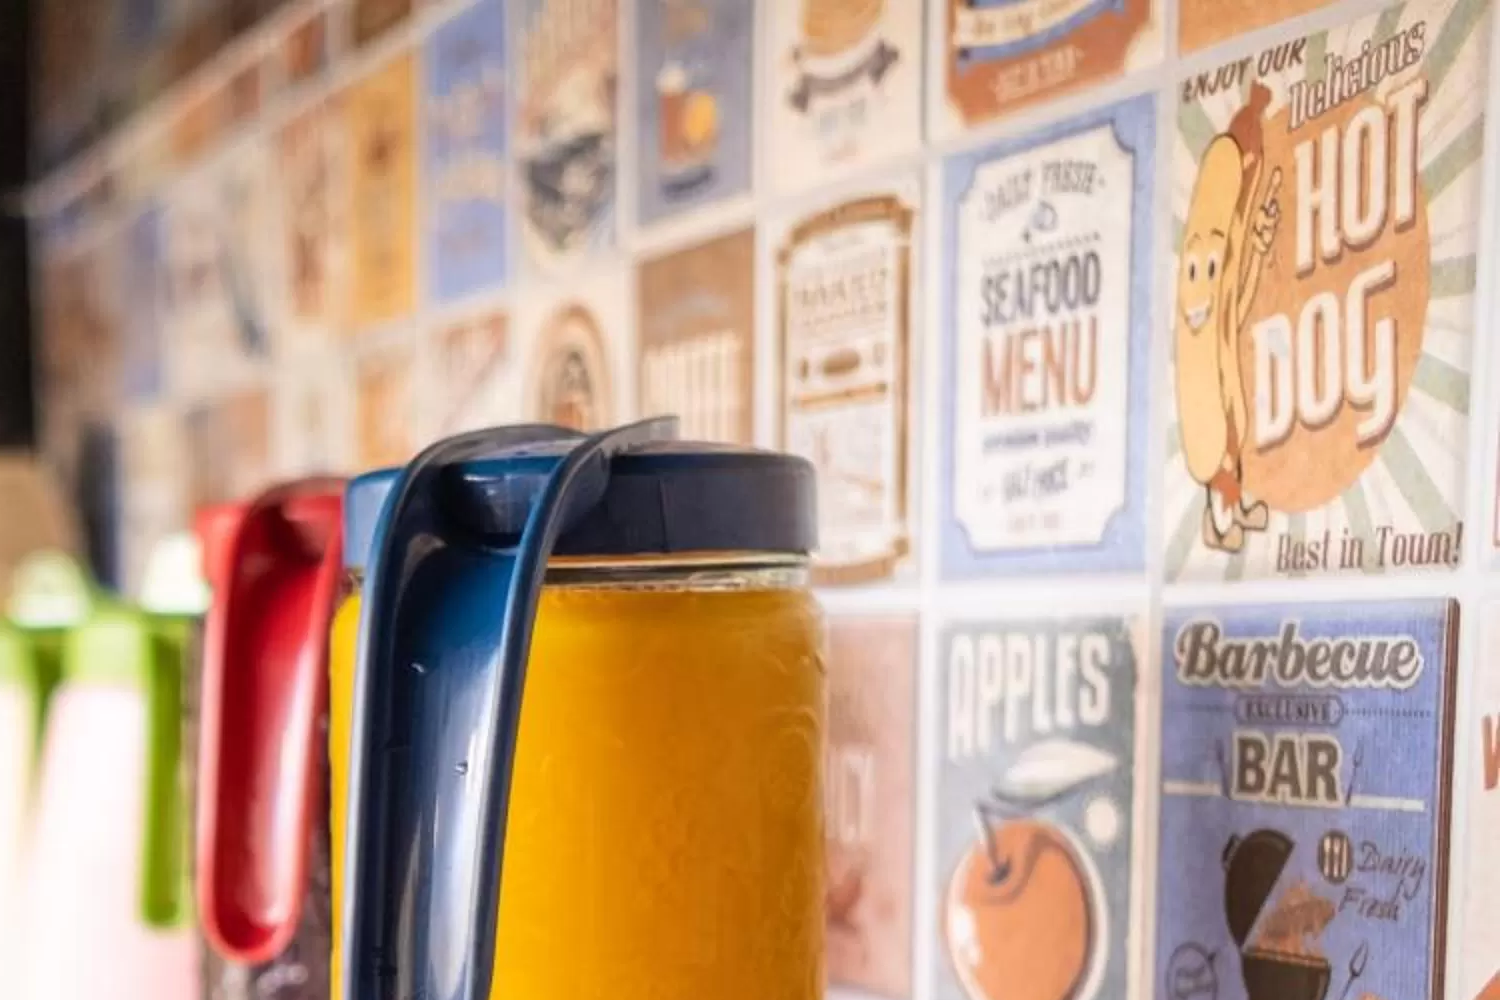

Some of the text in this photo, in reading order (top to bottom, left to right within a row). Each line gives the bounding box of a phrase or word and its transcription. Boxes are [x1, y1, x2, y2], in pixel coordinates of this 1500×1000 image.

[1182, 37, 1307, 104] ENJOY OUR
[1287, 20, 1427, 134] Delicious
[1293, 77, 1428, 277] HOT
[980, 249, 1100, 327] SEAFOOD
[980, 316, 1097, 417] MENU
[1251, 258, 1397, 456] DOG
[1276, 529, 1331, 574] Best
[1339, 527, 1365, 569] in
[1176, 619, 1421, 686] Barbecue
[947, 632, 1111, 766] APPLES
[1236, 736, 1340, 801] BAR
